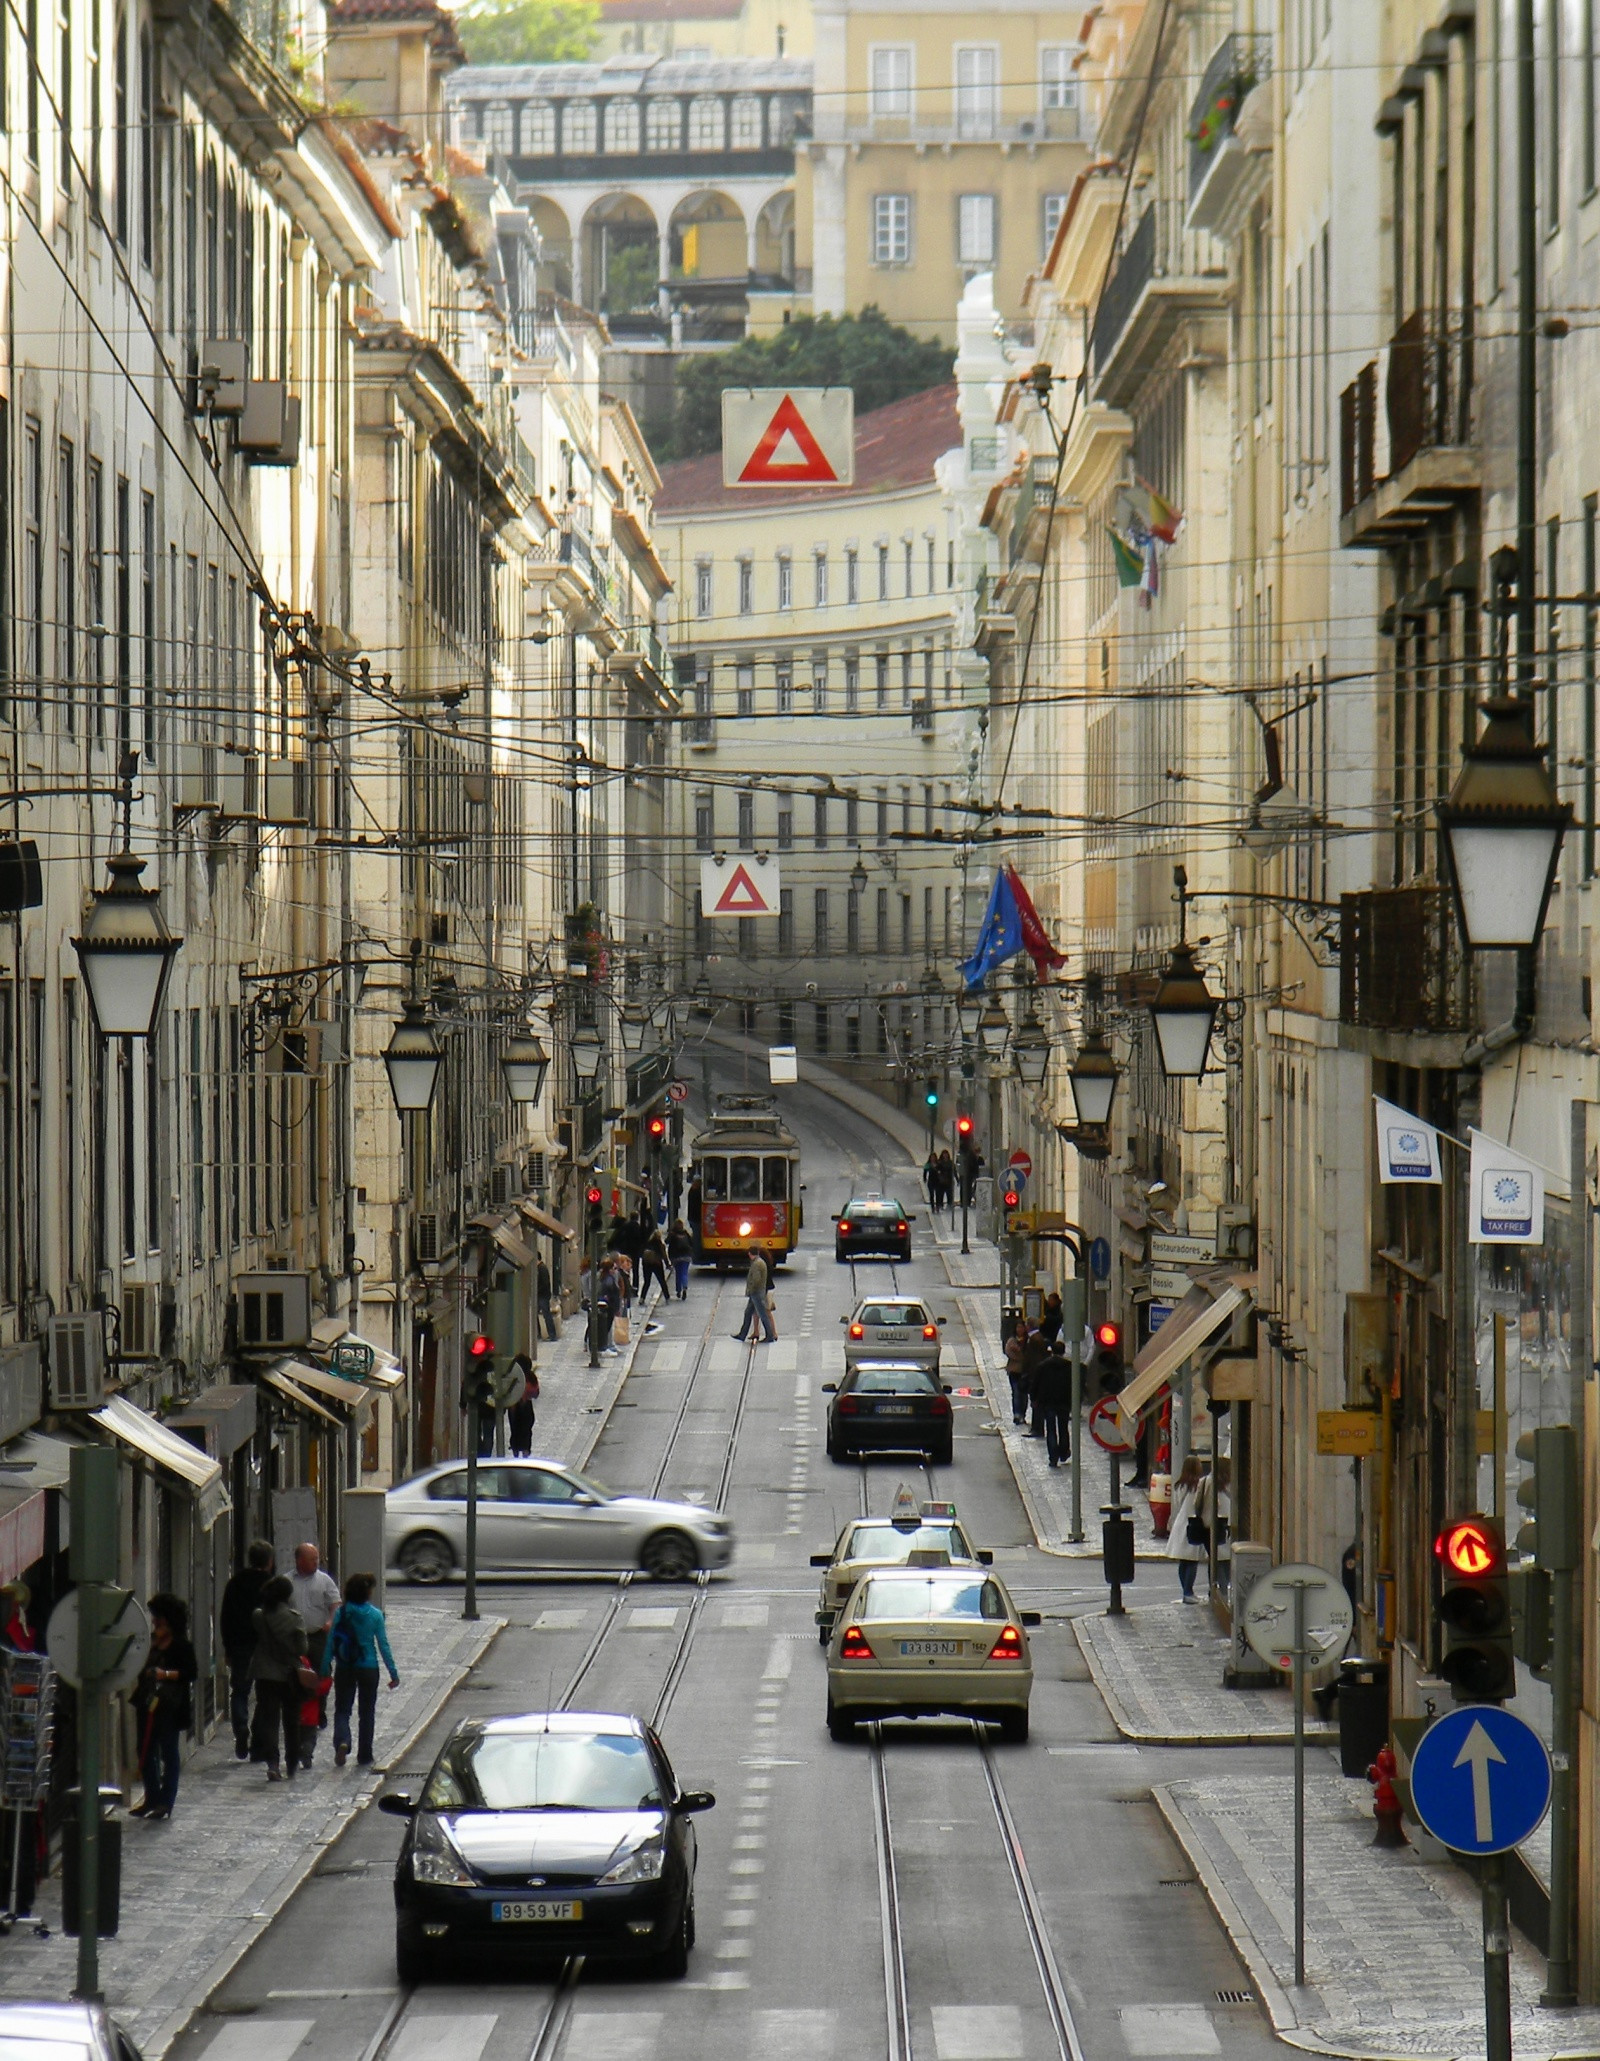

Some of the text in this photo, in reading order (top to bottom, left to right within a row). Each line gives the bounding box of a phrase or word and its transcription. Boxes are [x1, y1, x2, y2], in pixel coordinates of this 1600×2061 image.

[1409, 1166, 1426, 1174] FREE
[1488, 1222, 1525, 1232] TAX FREE
[1153, 1241, 1200, 1255] Restauradores
[1153, 1277, 1173, 1289] Rossio
